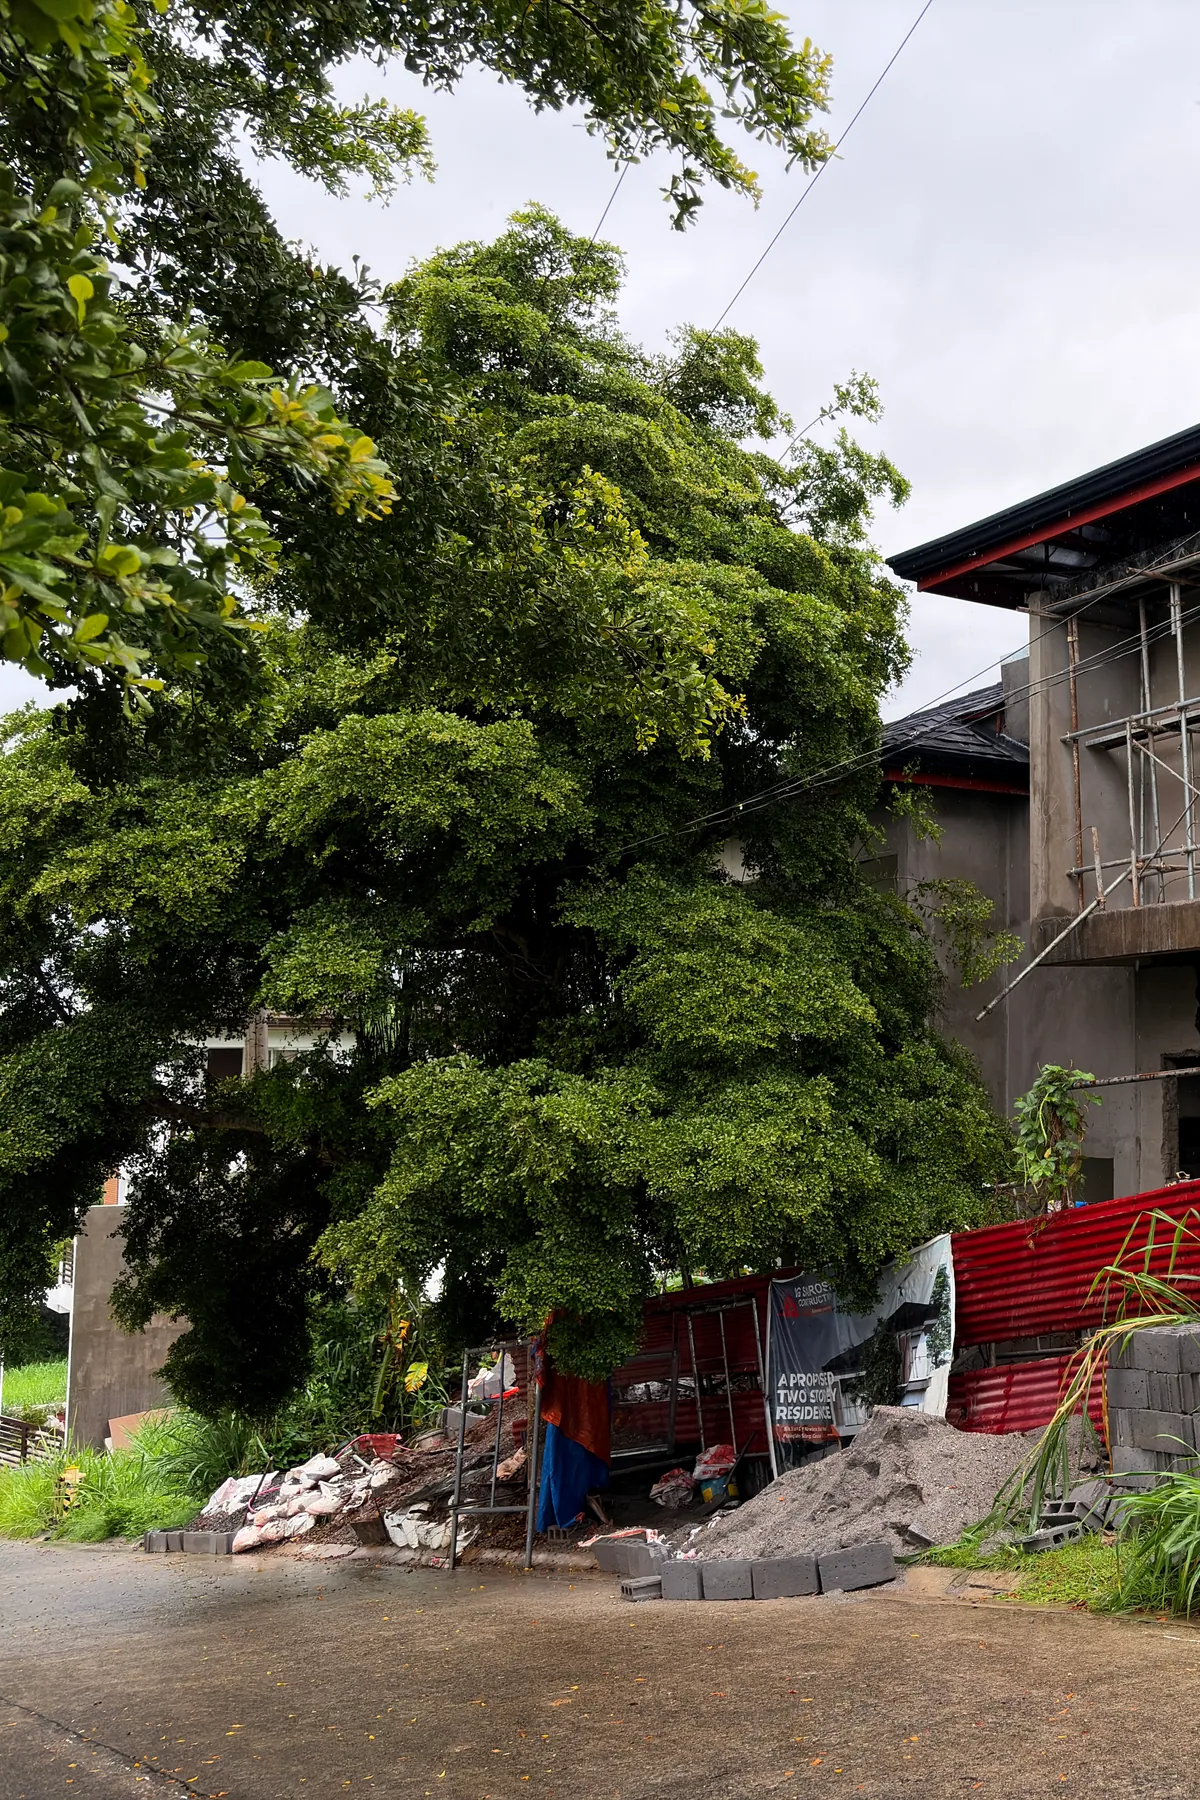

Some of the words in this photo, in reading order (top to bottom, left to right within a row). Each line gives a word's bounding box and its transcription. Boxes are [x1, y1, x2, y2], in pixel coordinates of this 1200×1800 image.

[777, 1373, 788, 1387] A
[777, 1390, 807, 1403] TWO
[776, 1406, 832, 1420] RESIDENCE
